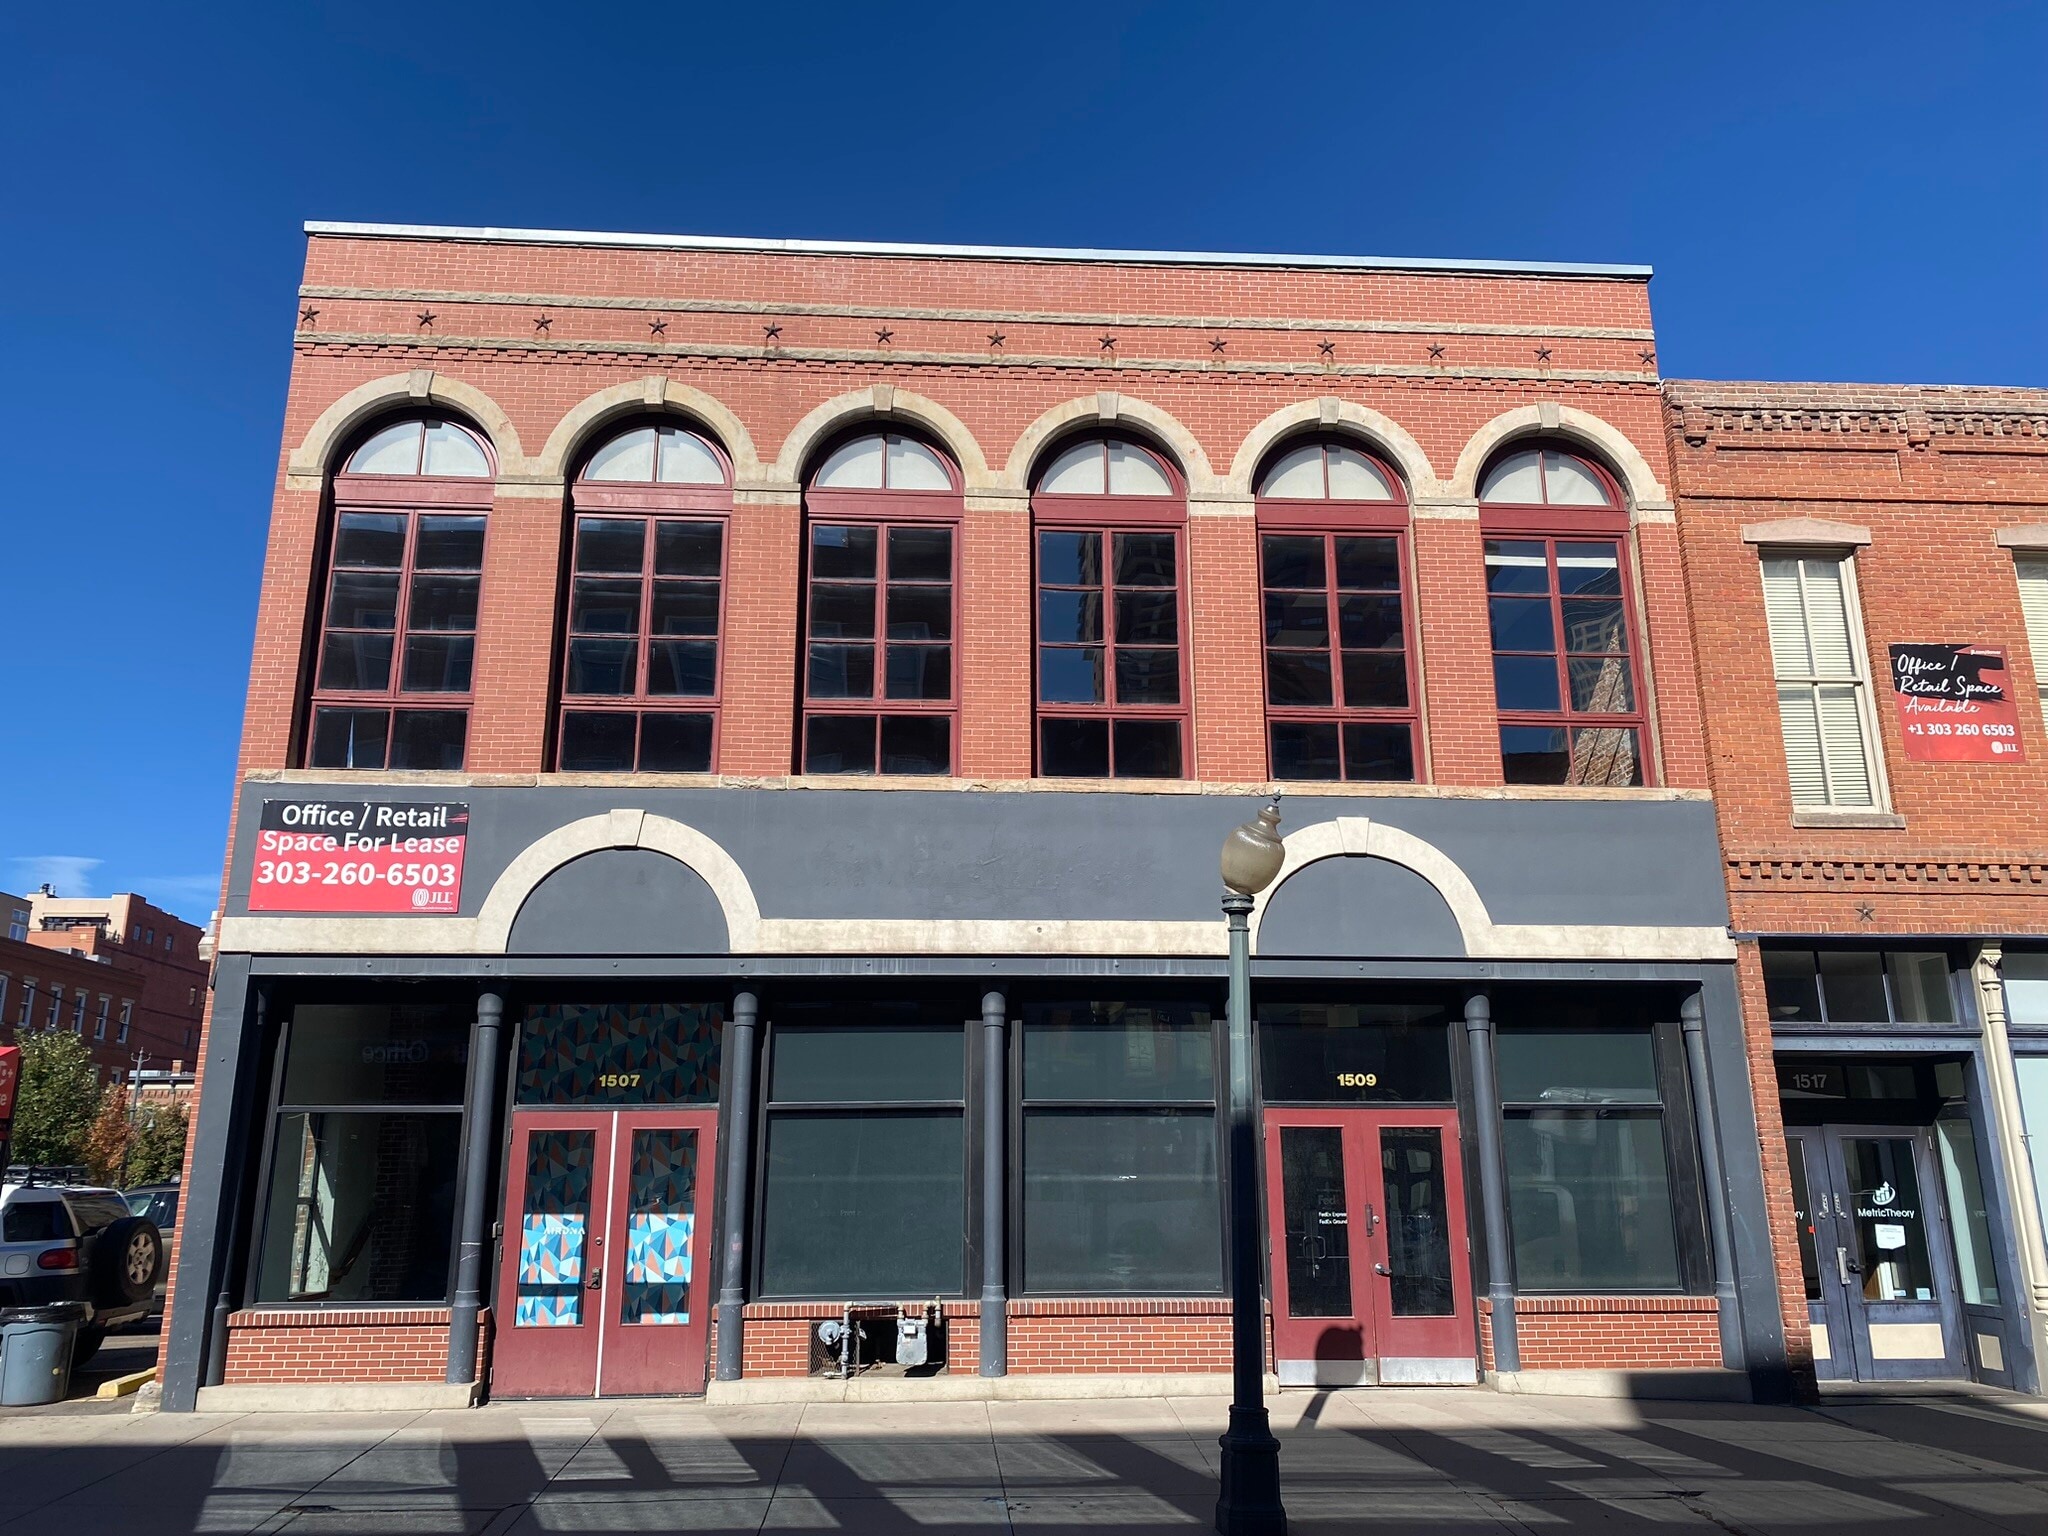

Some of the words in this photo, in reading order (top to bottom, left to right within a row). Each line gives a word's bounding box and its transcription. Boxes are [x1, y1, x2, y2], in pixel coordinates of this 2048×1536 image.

[1897, 653, 1946, 675] Office
[1899, 675, 1951, 694] Retail
[1954, 675, 2003, 698] Space
[1904, 695, 1981, 716] Available
[1907, 723, 1924, 735] +1
[1926, 723, 1952, 735] 303
[1954, 724, 1979, 736] 260
[1982, 724, 2015, 736] 6503
[282, 804, 354, 826] Office
[358, 805, 371, 830] /
[376, 806, 447, 827] Retail
[262, 830, 338, 856] Space
[343, 832, 385, 852] For
[390, 833, 460, 853] Lease
[257, 860, 456, 886] 303-260-6503
[429, 891, 453, 904] JLL
[599, 1074, 641, 1088] 1507
[1336, 1073, 1377, 1087] 1509
[1792, 1073, 1827, 1089] 1517
[1857, 1208, 1915, 1219] MetricTheory
